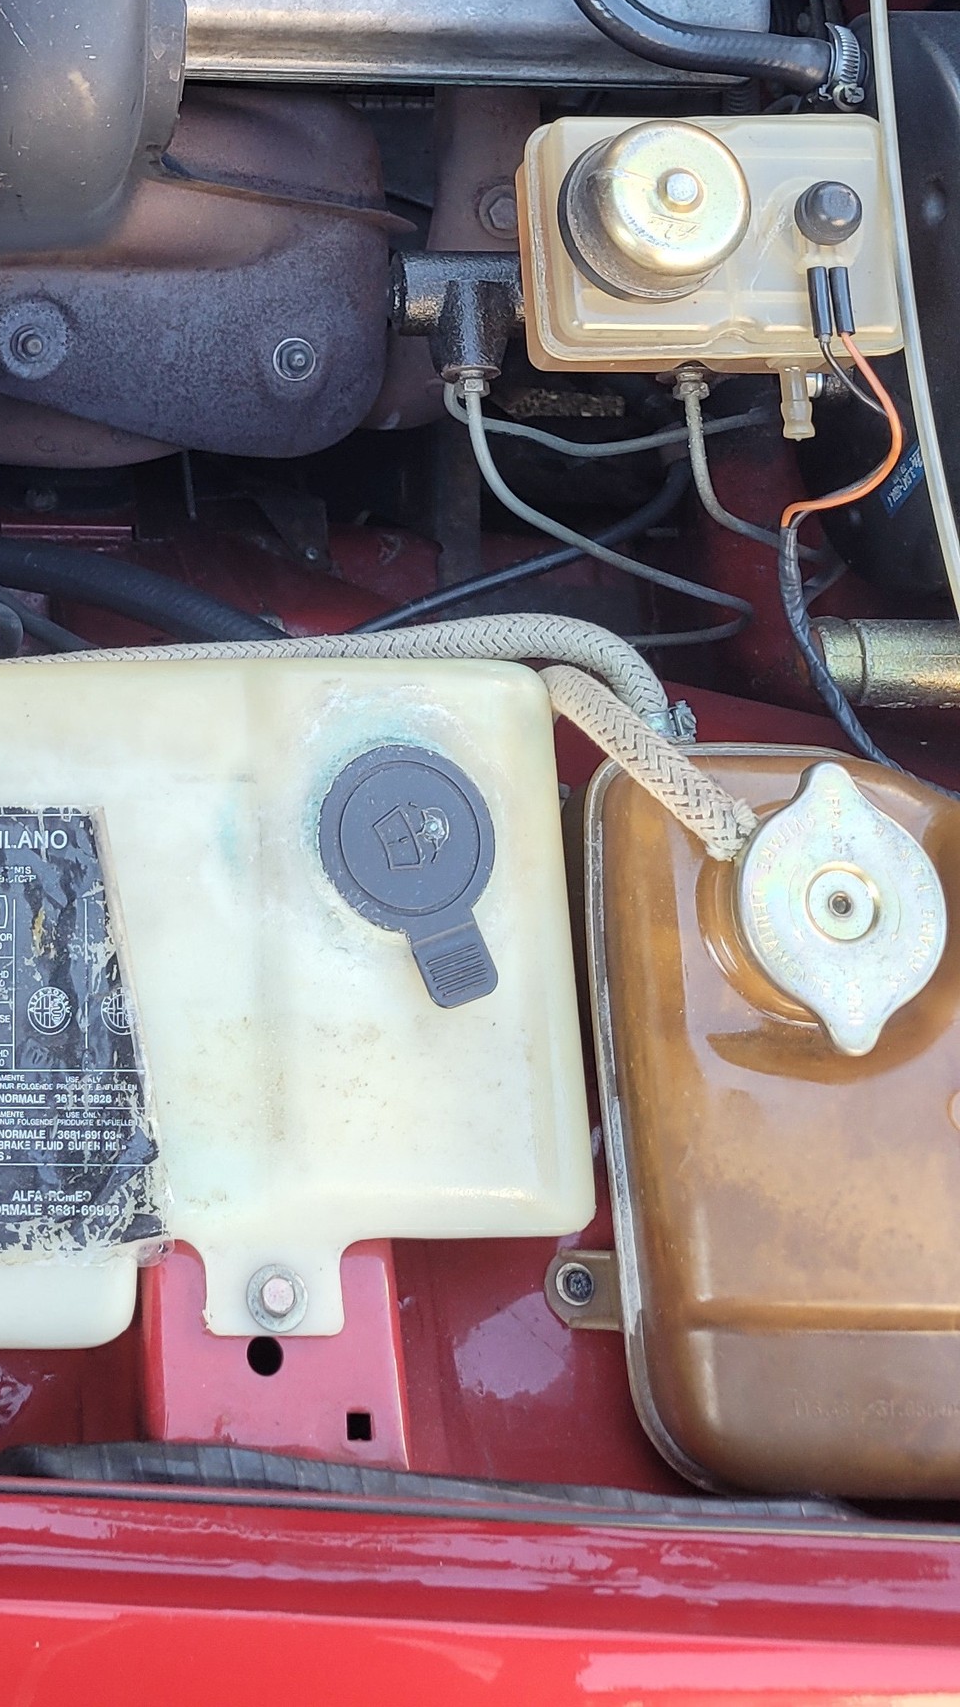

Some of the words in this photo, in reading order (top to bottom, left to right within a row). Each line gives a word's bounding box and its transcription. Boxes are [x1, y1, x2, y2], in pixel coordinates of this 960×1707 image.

[0, 1083, 15, 1091] NUR
[16, 1083, 53, 1091] FOLGENDE
[35, 1140, 64, 1150] FLUID
[12, 1190, 43, 1202] ALFA
